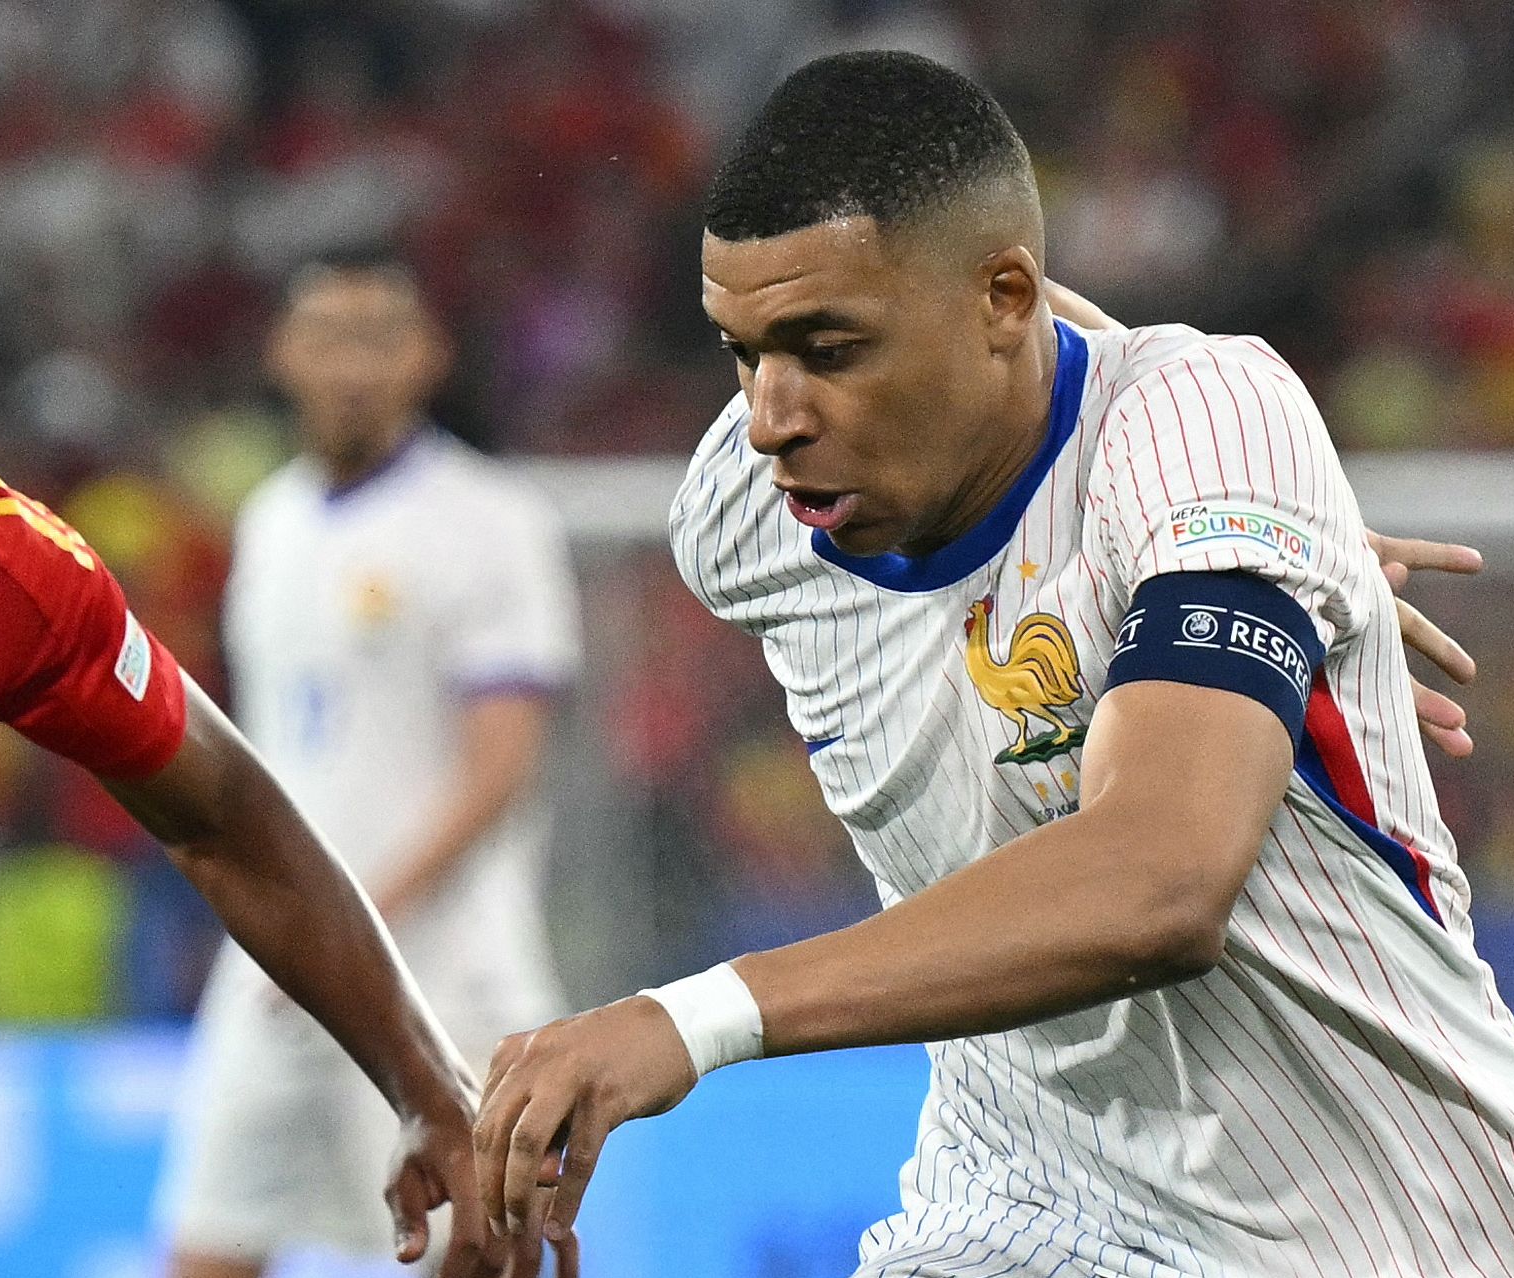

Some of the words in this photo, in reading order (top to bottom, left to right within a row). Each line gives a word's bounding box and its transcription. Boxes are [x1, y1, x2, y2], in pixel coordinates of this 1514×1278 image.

[1171, 506, 1208, 522] UEFA
[1172, 517, 1312, 563] FOUNDATION
[1231, 620, 1310, 703] RESPEC
